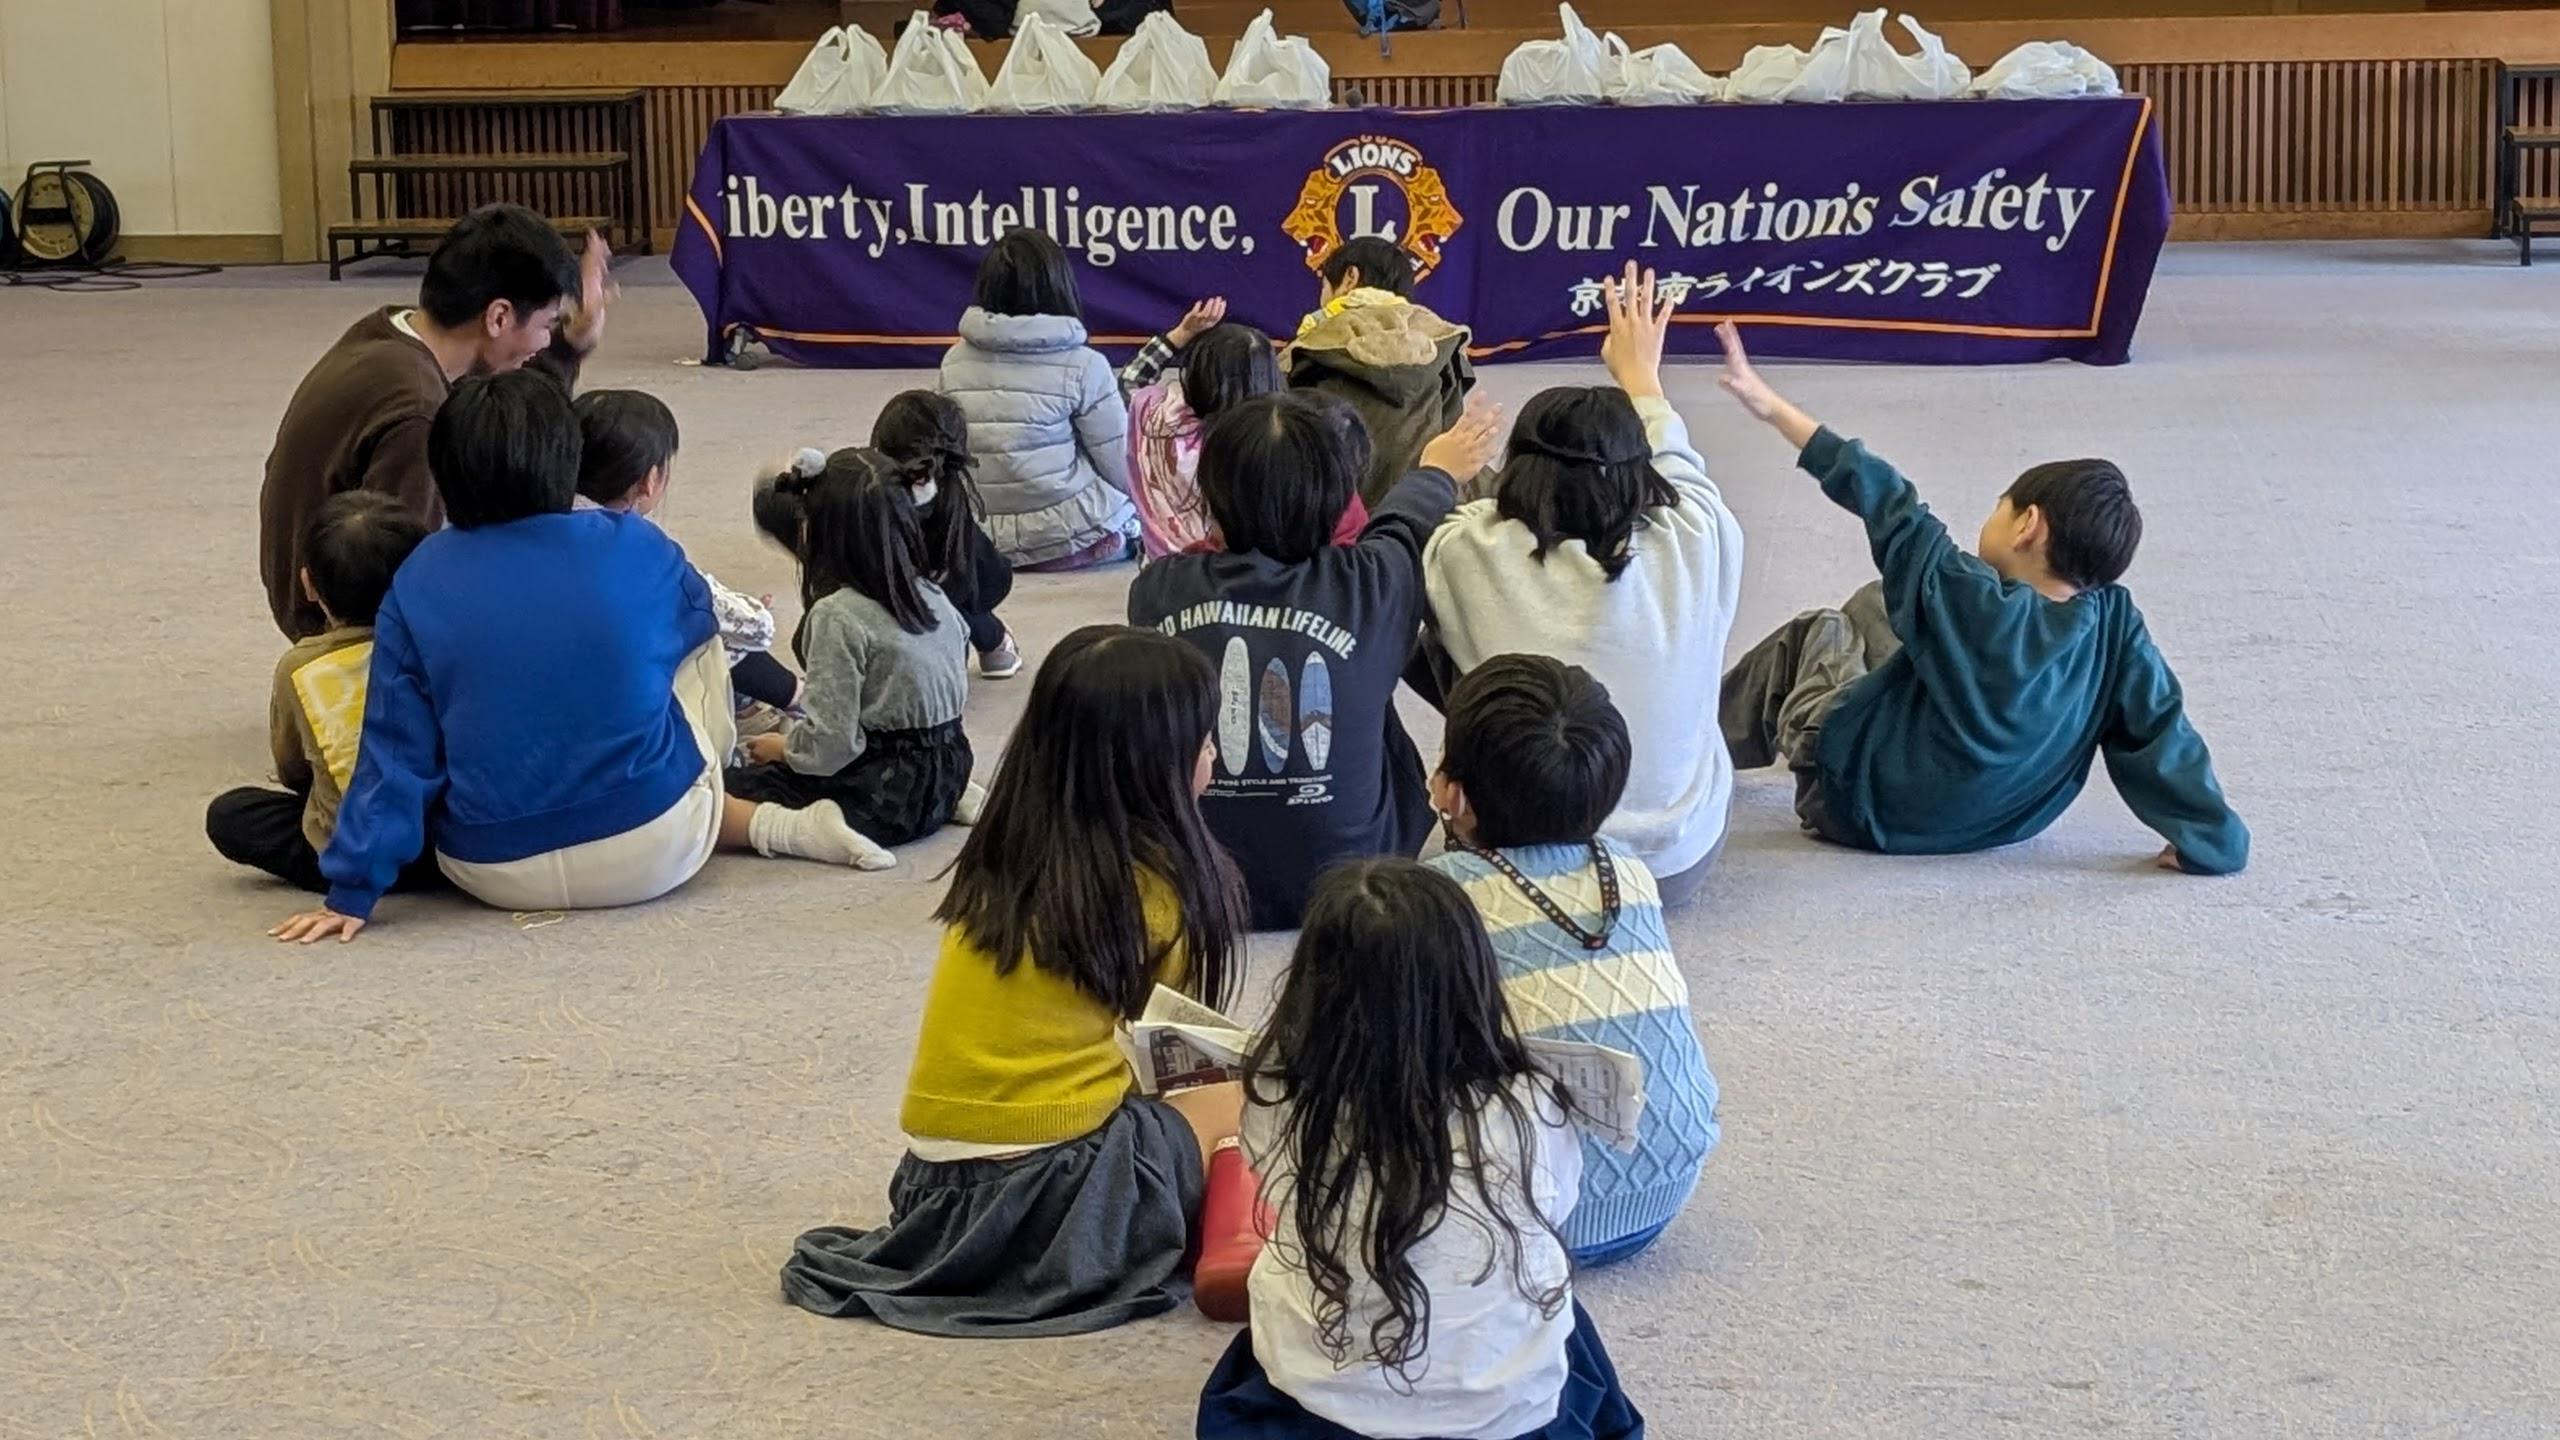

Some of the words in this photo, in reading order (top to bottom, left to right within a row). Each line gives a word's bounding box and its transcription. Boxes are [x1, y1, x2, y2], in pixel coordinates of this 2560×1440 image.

[1331, 143, 1417, 176] LIONS
[718, 174, 907, 258] iberty,
[1349, 185, 1397, 244] L
[1497, 186, 1630, 253] Our
[1638, 182, 1878, 249] Nation's
[1889, 168, 2096, 252] Safety
[1180, 600, 1280, 631] HAWAIIAN
[1281, 607, 1357, 660] LIFELINE
